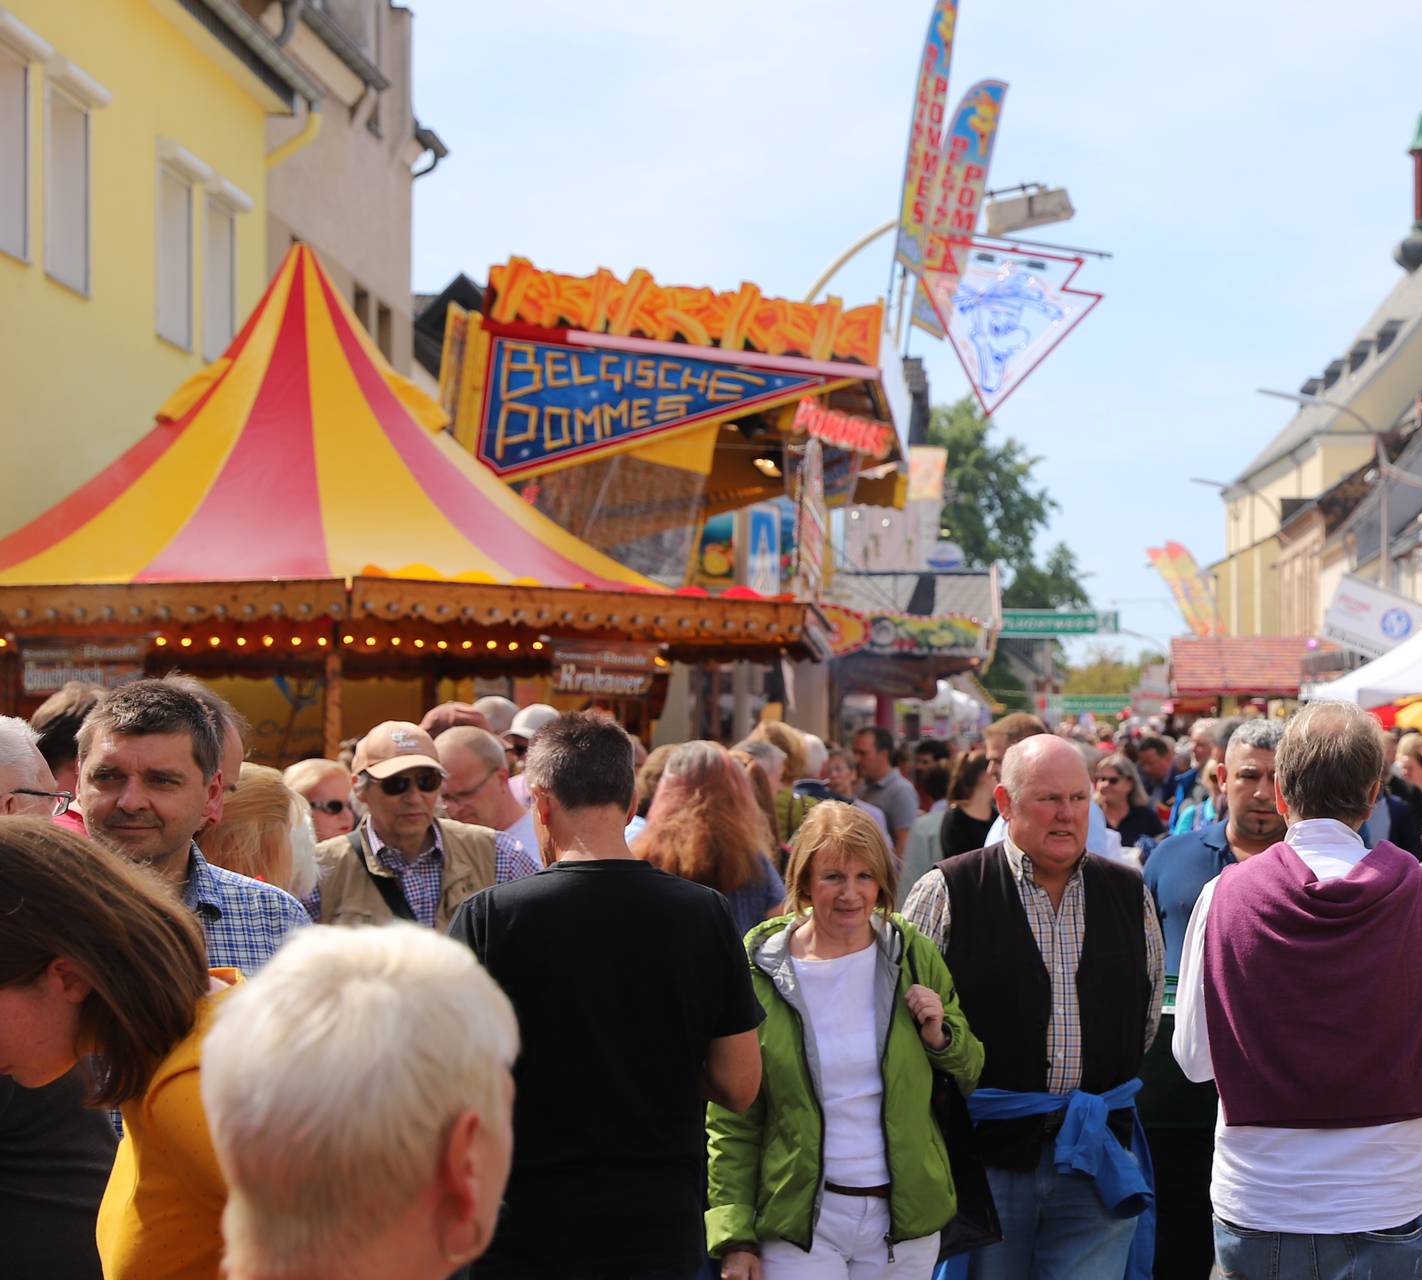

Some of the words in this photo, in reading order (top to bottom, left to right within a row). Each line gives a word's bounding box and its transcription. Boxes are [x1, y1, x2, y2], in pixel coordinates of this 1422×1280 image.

[912, 75, 948, 224] POMMES
[502, 342, 767, 401] BELGISCHE
[494, 394, 694, 460] POMMES
